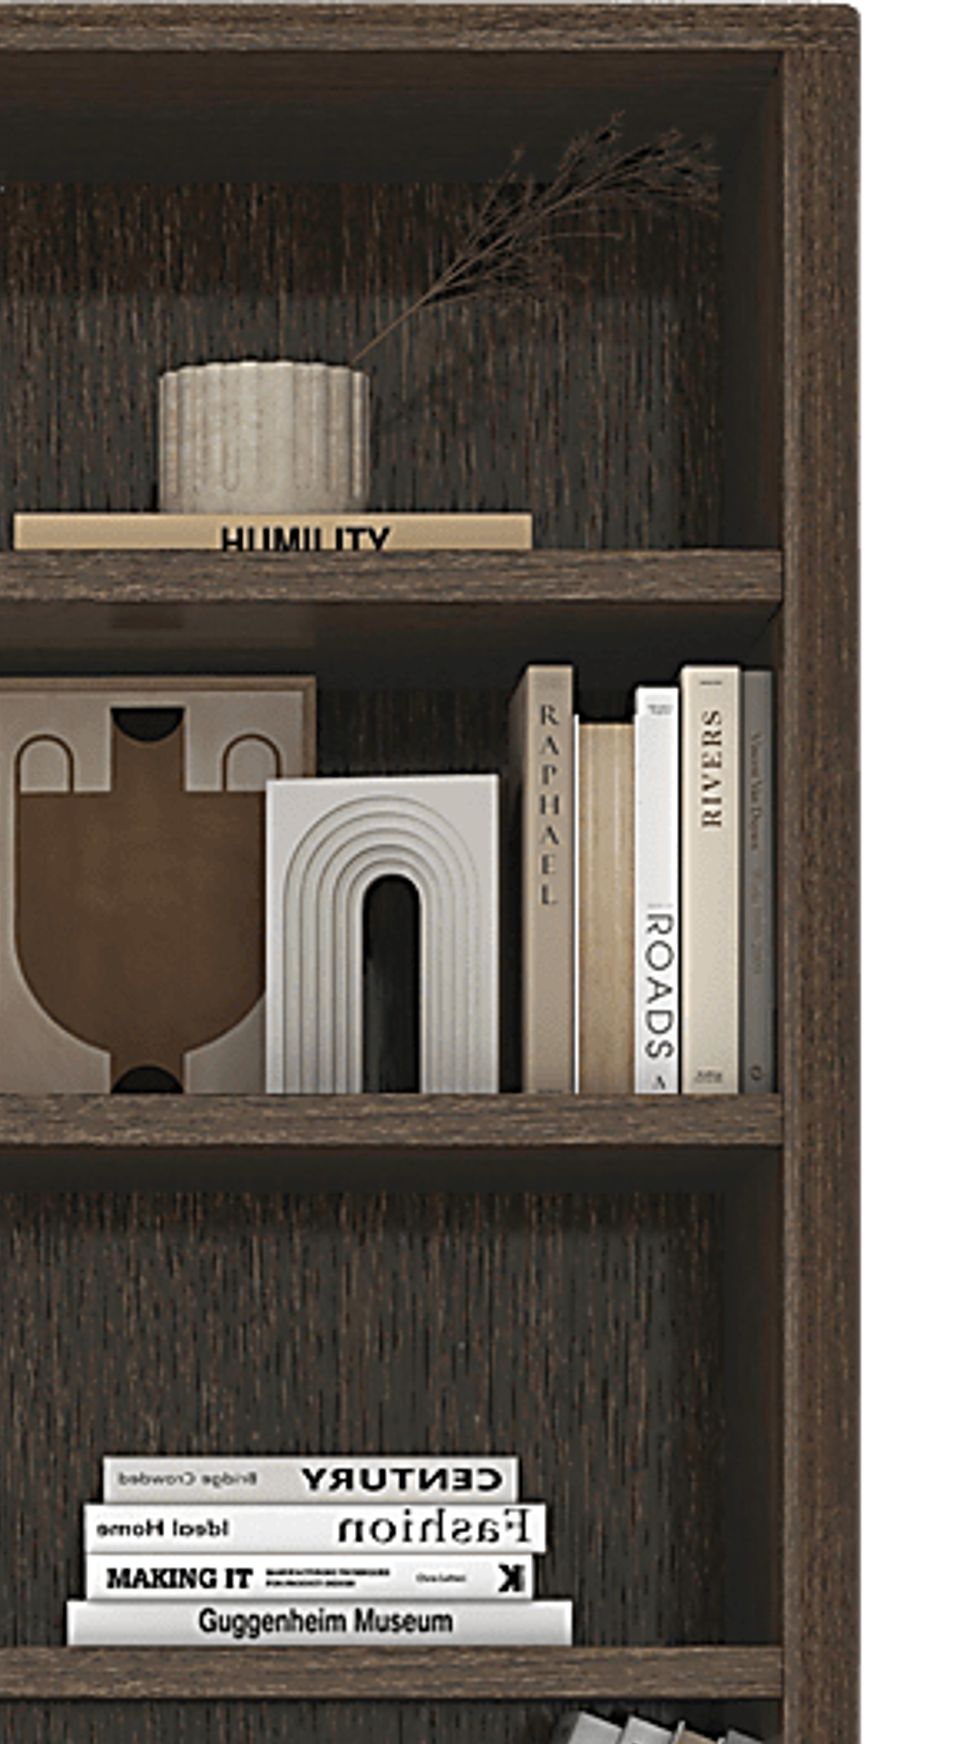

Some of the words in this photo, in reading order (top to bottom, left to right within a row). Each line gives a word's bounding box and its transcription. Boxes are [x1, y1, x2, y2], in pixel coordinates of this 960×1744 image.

[221, 527, 391, 551] HUMILITY
[540, 704, 560, 905] RAPHAEL
[701, 710, 723, 828] RIVERS
[644, 913, 675, 1059] ROADS
[106, 1568, 217, 1589] MAKING
[225, 1568, 254, 1589] IT
[199, 1608, 346, 1639] Guggenheim
[355, 1608, 453, 1633] Museum
